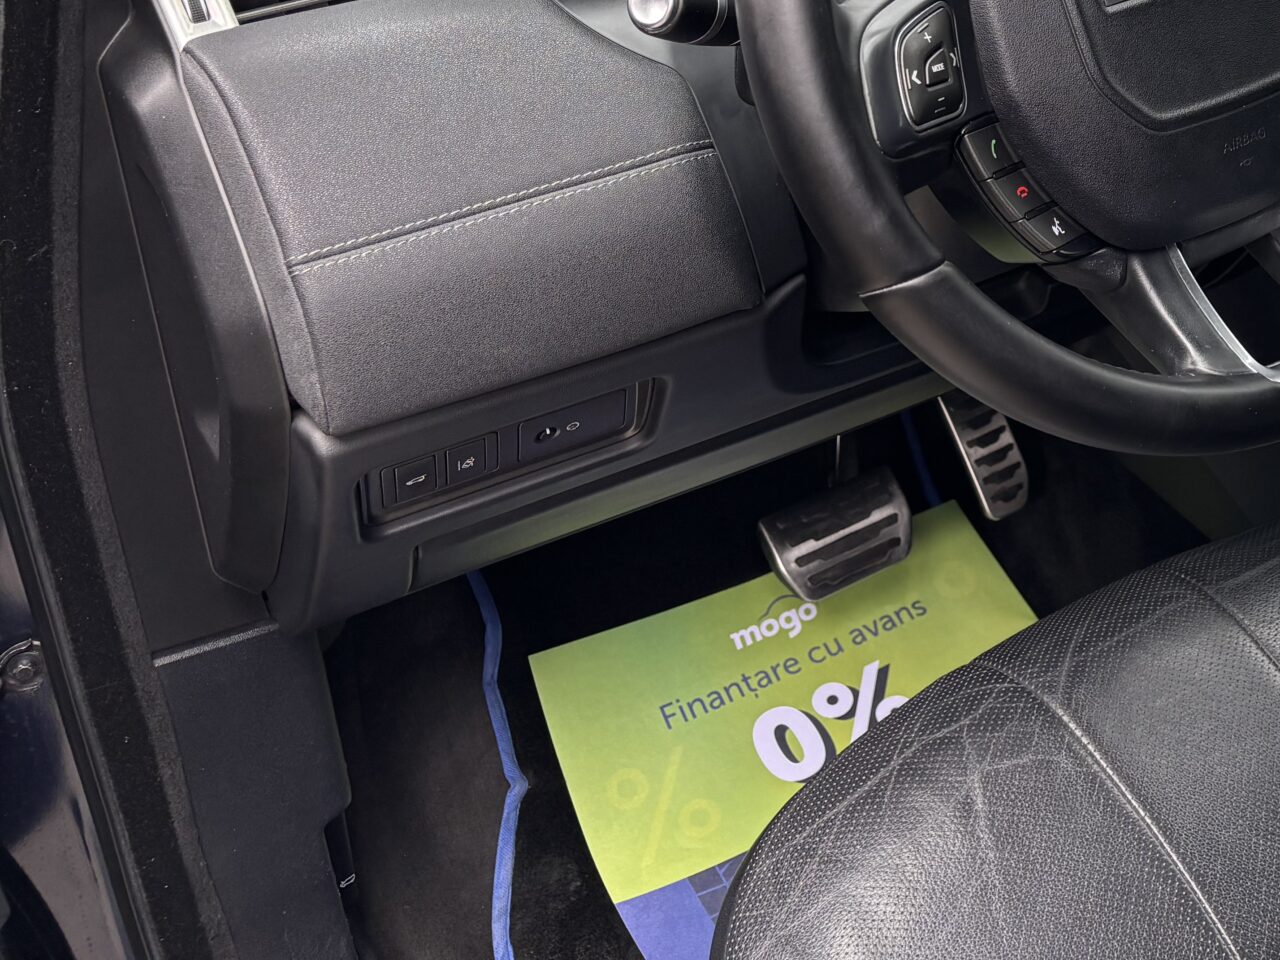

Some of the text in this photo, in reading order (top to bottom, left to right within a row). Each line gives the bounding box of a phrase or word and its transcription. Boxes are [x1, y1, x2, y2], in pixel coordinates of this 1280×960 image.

[931, 62, 945, 73] MODE
[1223, 126, 1266, 155] AIRBAG
[729, 601, 818, 650] mogo
[657, 598, 929, 731] Finanțare cu avans
[752, 660, 910, 782] 0%
